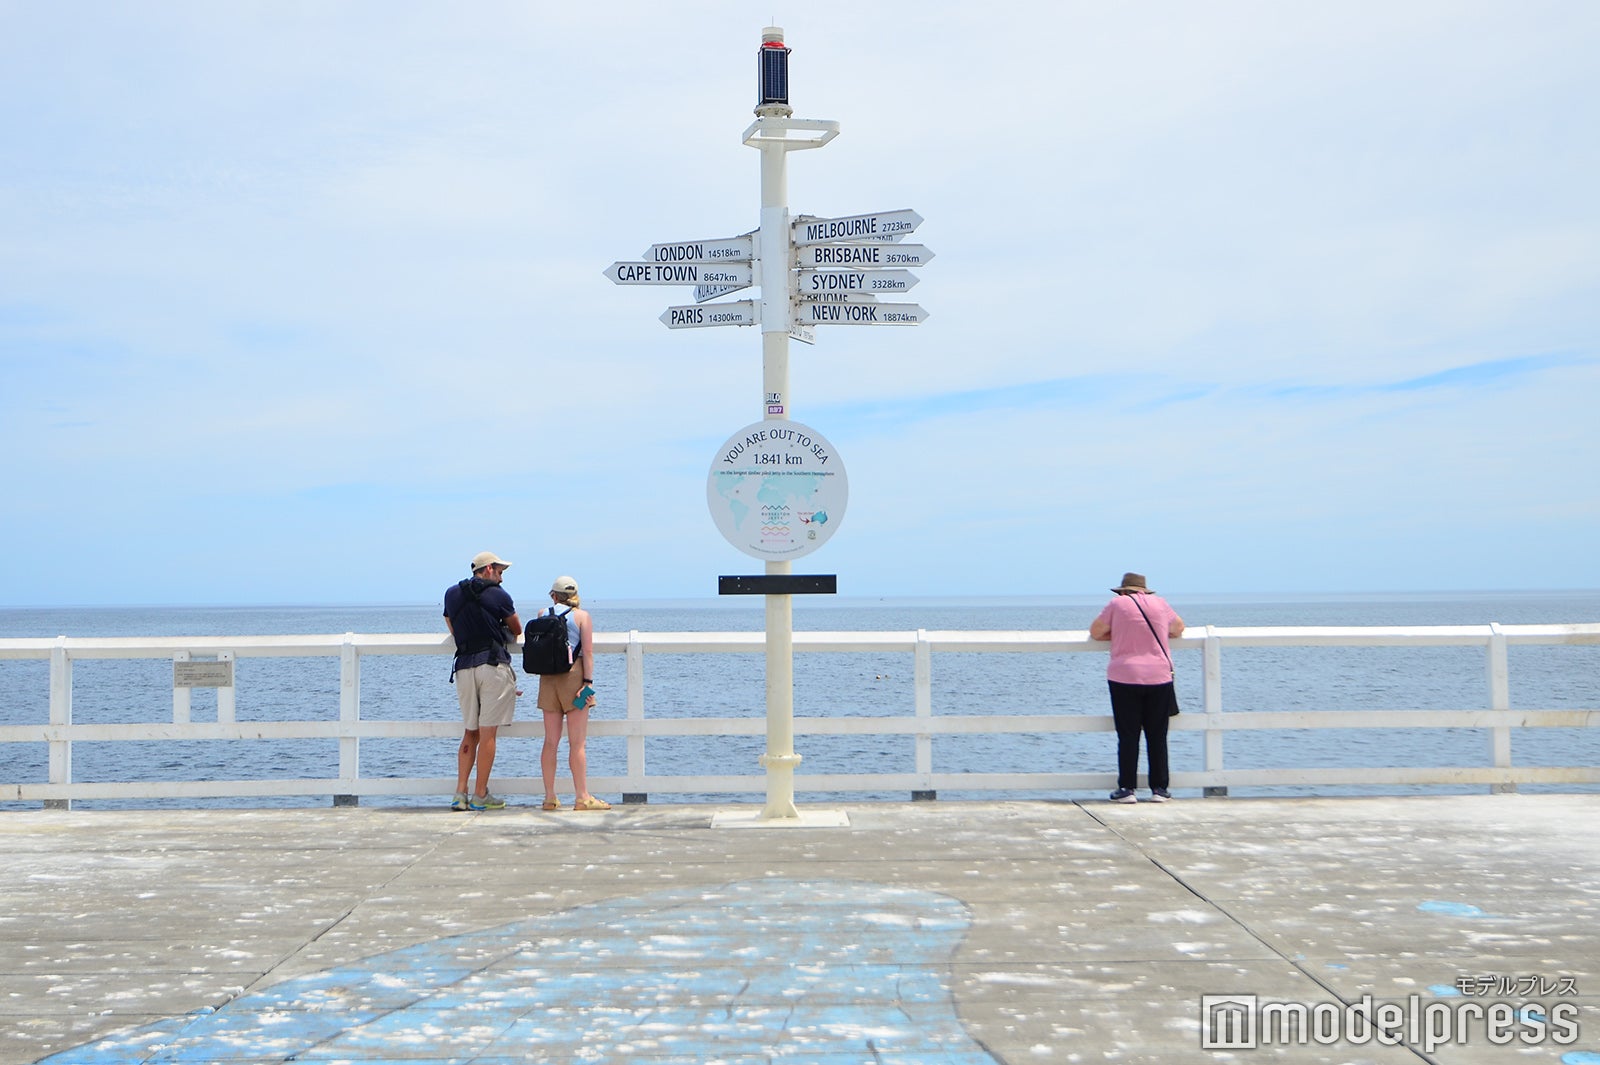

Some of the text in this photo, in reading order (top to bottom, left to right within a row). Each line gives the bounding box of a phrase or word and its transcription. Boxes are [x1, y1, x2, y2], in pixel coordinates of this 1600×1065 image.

[807, 217, 912, 241] MELBOURNE 2723km
[655, 244, 741, 262] LONDON 14518km
[815, 248, 920, 263] BRISBANE 3670km
[617, 265, 737, 282] CAPE TOWN 8647km
[812, 273, 905, 290] SYDNEY 3328km
[671, 308, 743, 325] PARIS 14300km
[812, 305, 917, 322] NEW YORK 18874km
[723, 428, 829, 465] YOU ARE OUT TO SEA
[754, 453, 803, 465] 1.841 km
